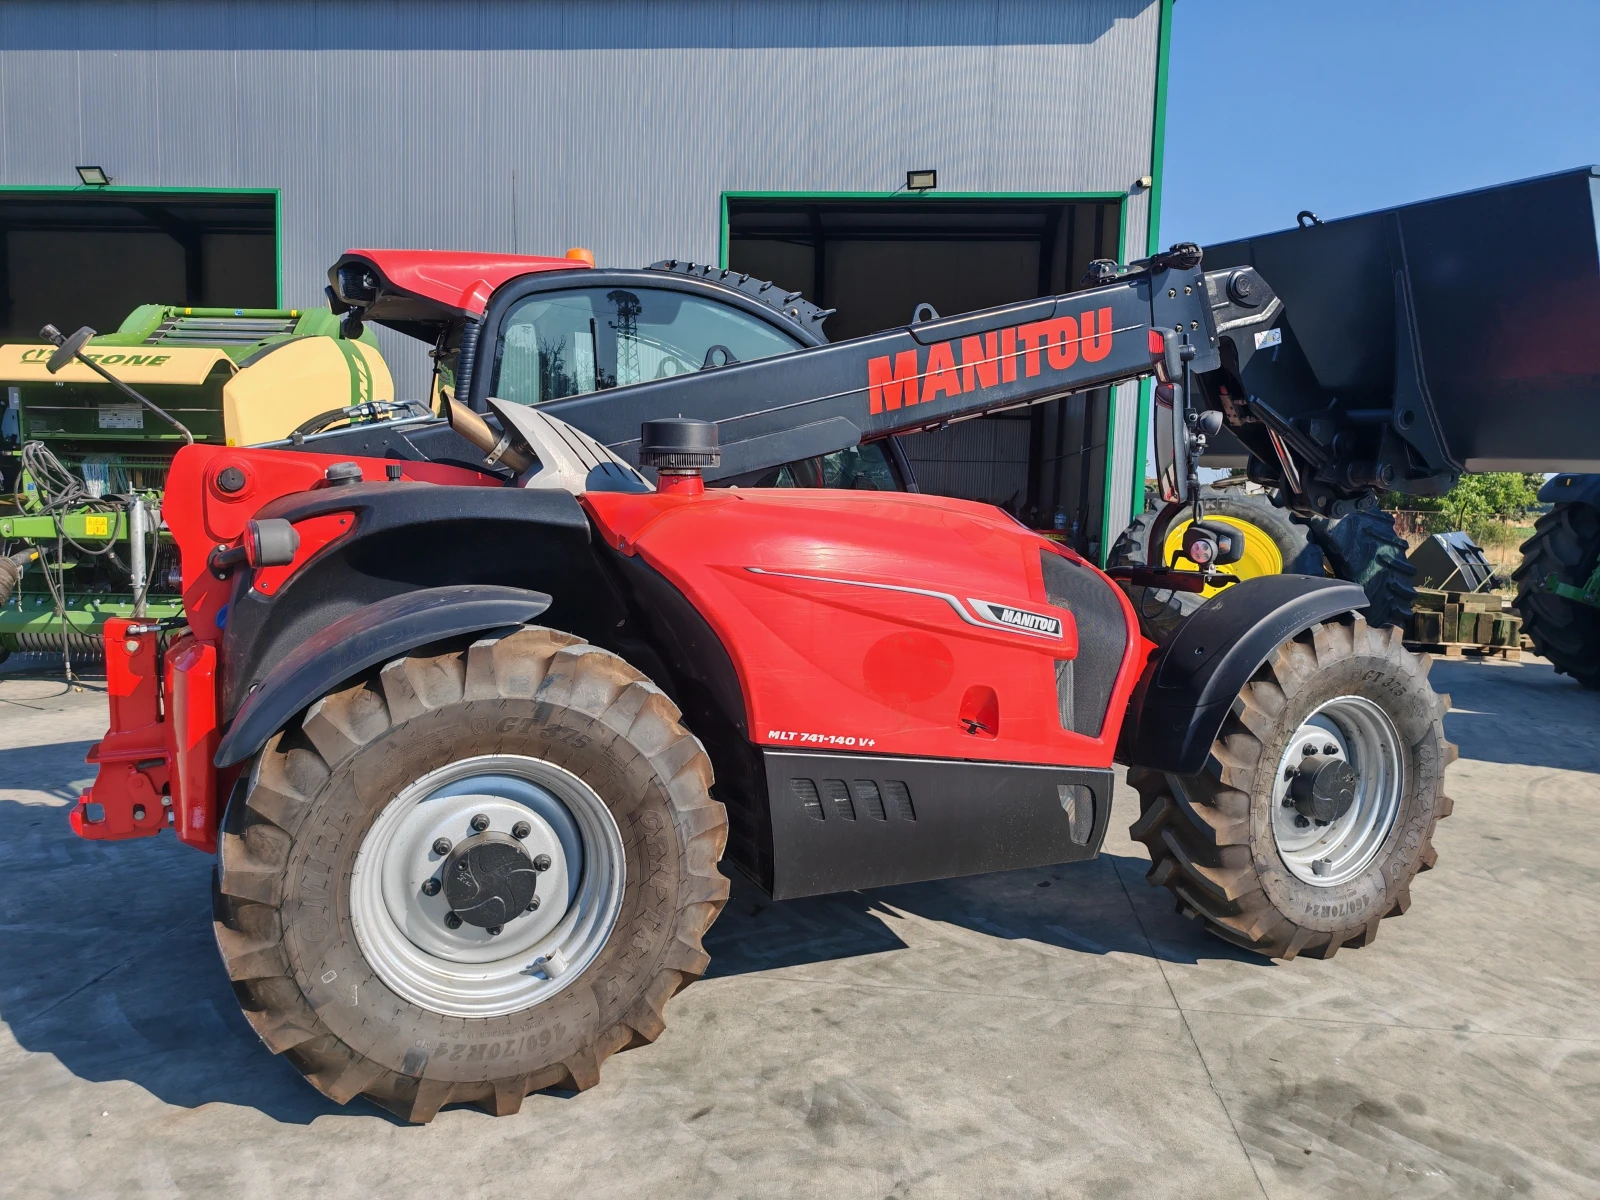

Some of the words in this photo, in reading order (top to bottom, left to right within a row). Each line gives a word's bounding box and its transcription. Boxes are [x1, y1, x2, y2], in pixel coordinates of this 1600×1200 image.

[868, 307, 1113, 415] MANITOU
[1001, 608, 1057, 632] MANITOU
[1362, 670, 1384, 682] GT
[1381, 677, 1407, 697] 375
[496, 716, 541, 735] GT
[540, 722, 594, 750] 375
[768, 730, 798, 740] MLT
[800, 732, 856, 745] 741-140
[859, 738, 875, 747] V+
[1304, 893, 1370, 918] 460/70R24
[431, 1021, 567, 1063] 460/70R24
